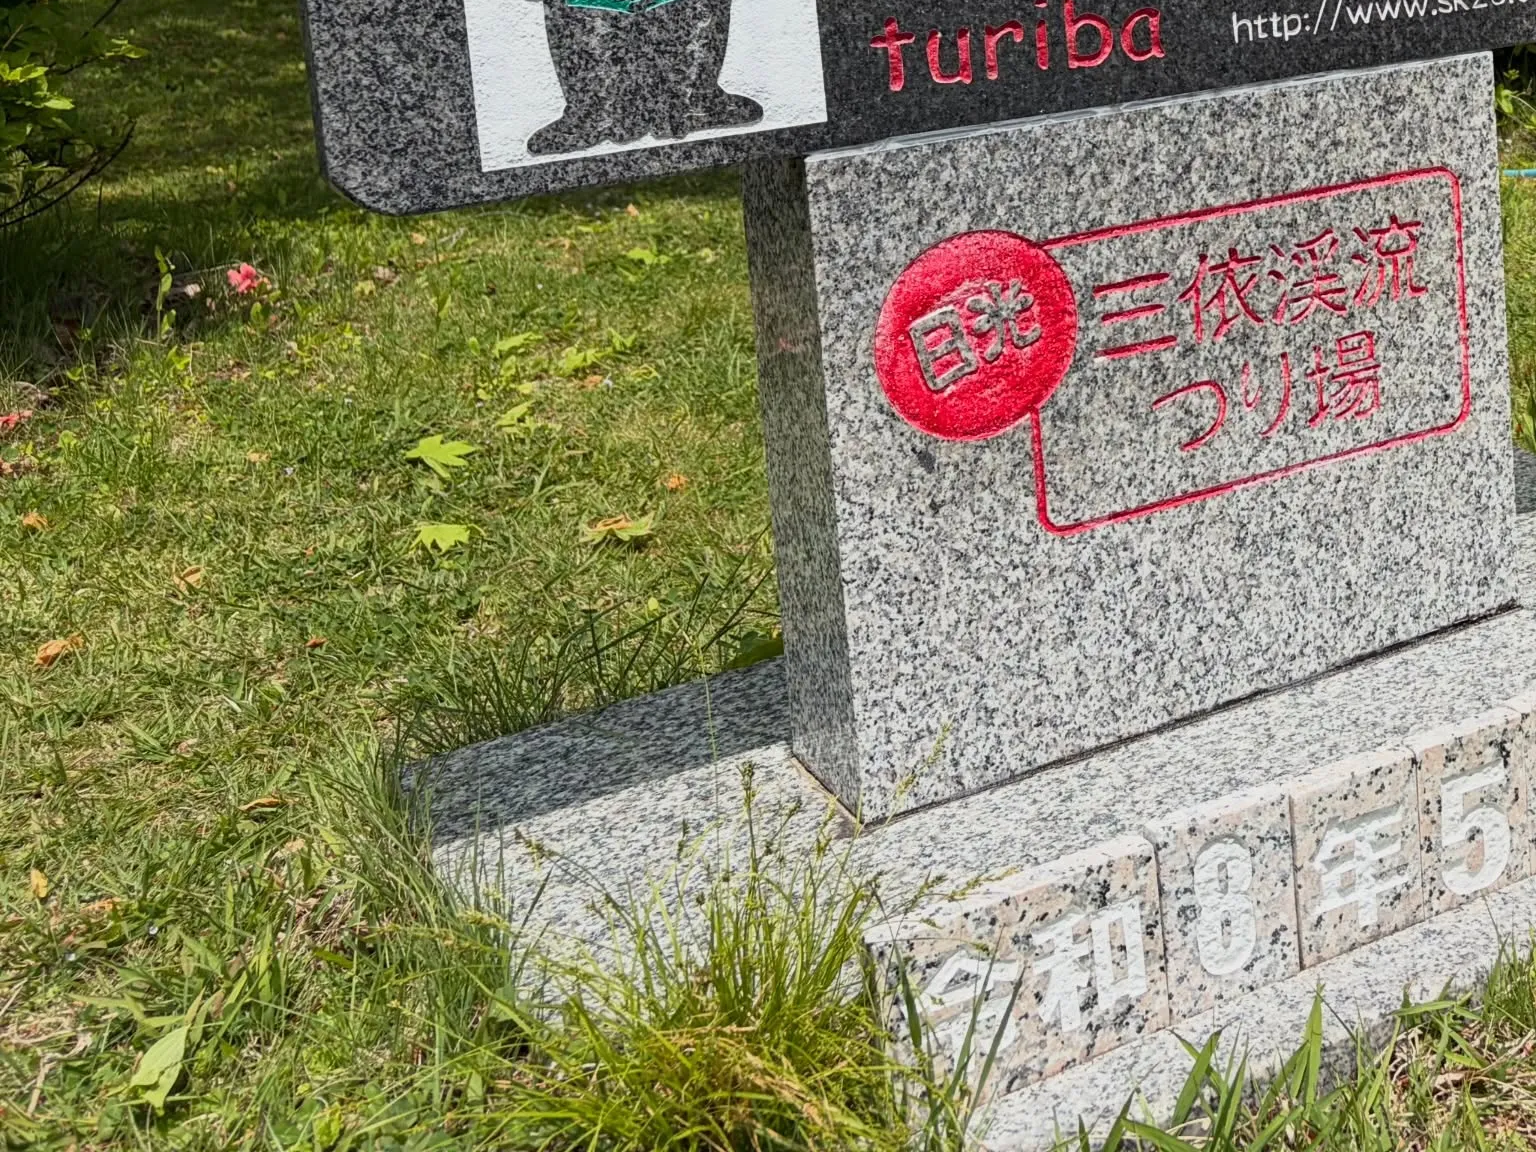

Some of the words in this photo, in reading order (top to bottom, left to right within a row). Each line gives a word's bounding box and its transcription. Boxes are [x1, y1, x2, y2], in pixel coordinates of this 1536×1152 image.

[907, 277, 1043, 392] 日光
[1093, 214, 1427, 362] 三依渓流
[1151, 329, 1383, 453] つり場
